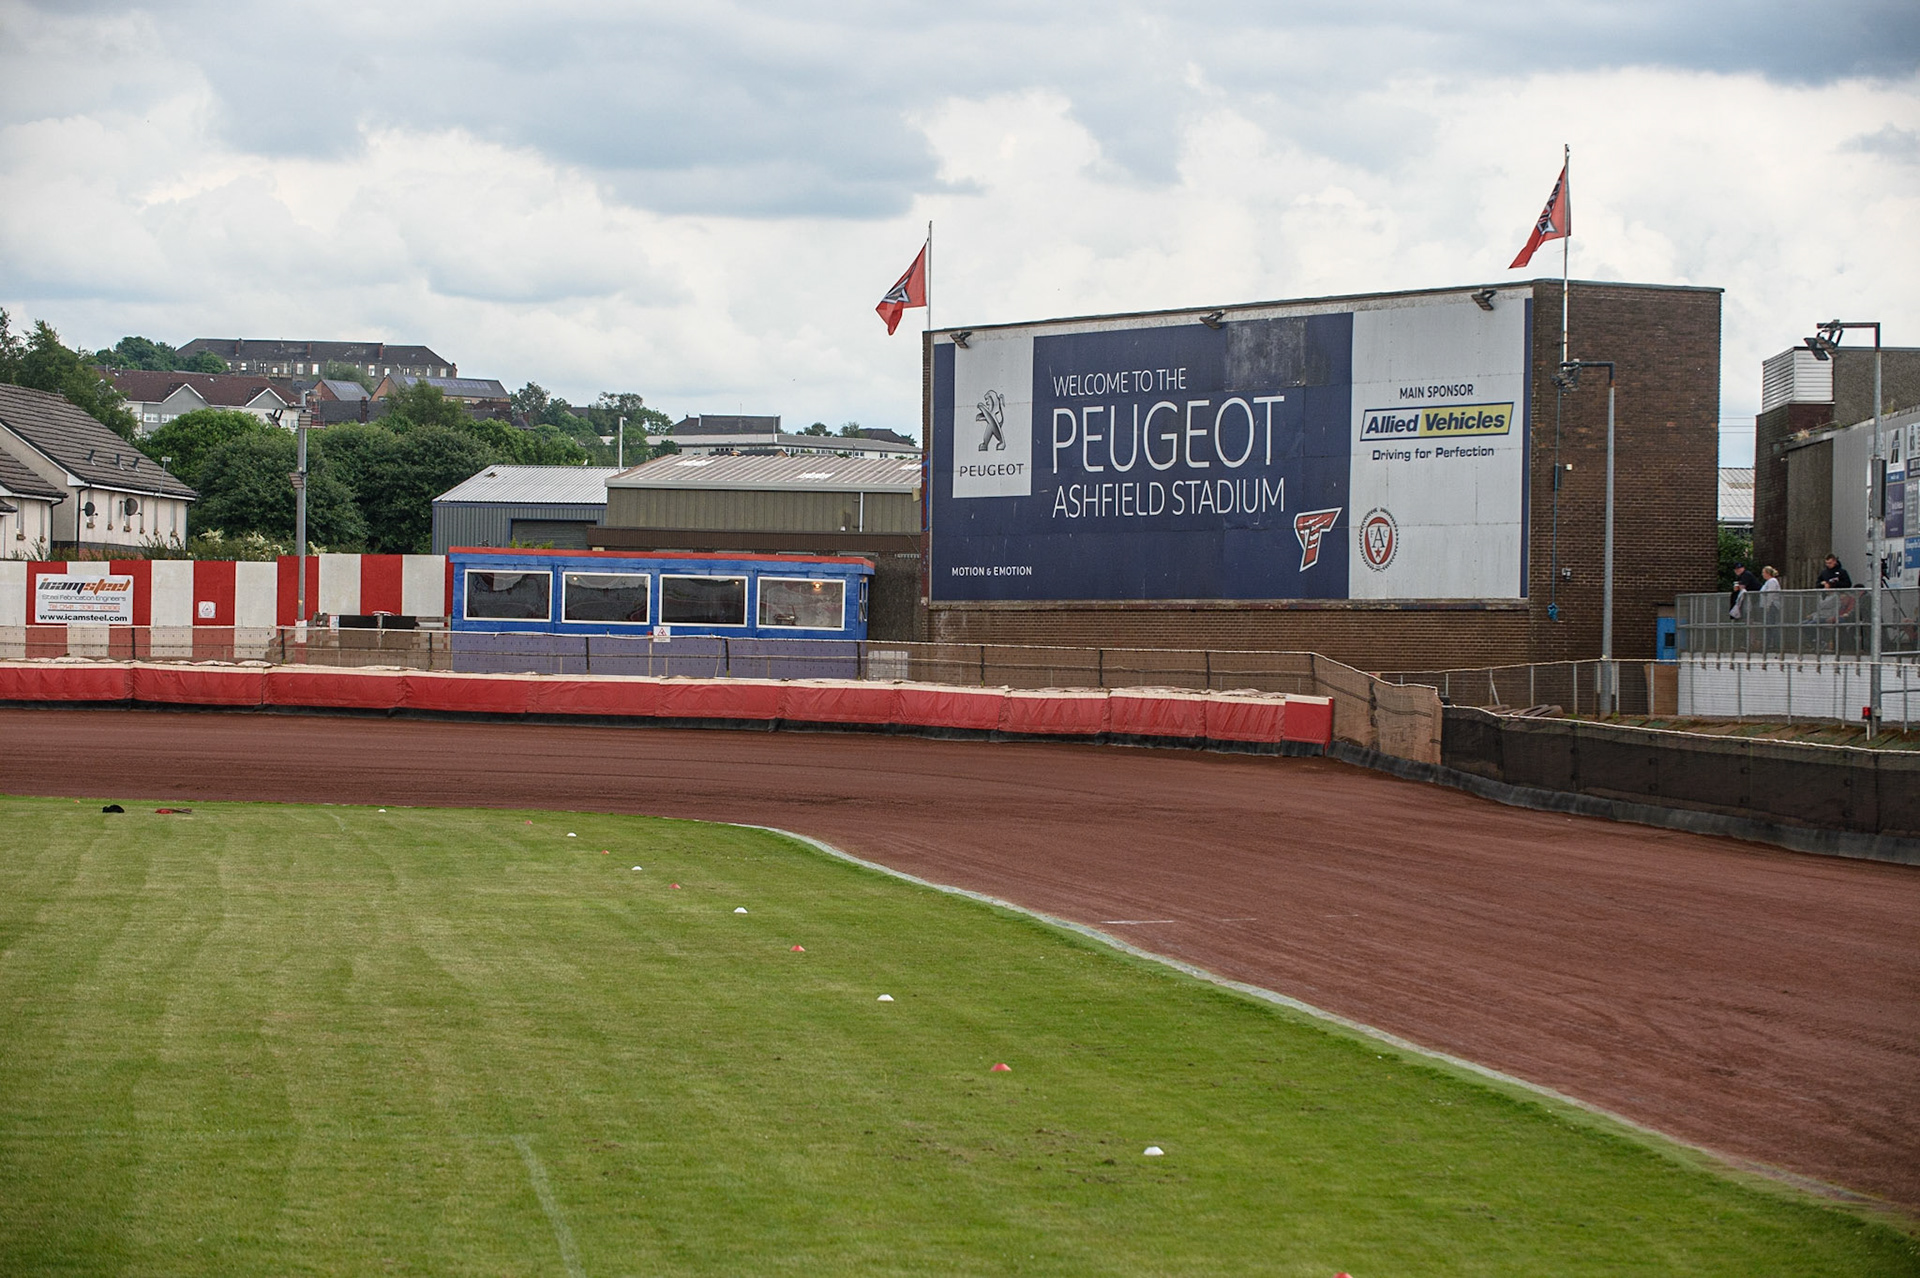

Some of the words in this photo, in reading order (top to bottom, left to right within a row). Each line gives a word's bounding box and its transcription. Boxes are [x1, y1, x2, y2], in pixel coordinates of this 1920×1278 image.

[1052, 371, 1129, 397] WELCOME
[1132, 370, 1153, 393] TO
[1156, 367, 1187, 391] THE
[1399, 385, 1425, 400] MAIN
[1427, 383, 1474, 398] SPONSOR
[1365, 414, 1420, 434] Allied
[1424, 410, 1506, 432] Vehicles
[1052, 395, 1286, 474] PEUGEOT
[1371, 449, 1412, 462] Driving
[1415, 448, 1432, 459] for
[1435, 446, 1495, 459] Perfection
[959, 462, 1025, 477] PEUGEOT
[1052, 481, 1166, 518] ASHFIELD
[1172, 476, 1286, 516] STADIUM
[951, 566, 985, 577] MOTION
[986, 567, 993, 577] &
[993, 565, 1032, 577] EMOTION
[39, 578, 131, 595] icamsteel
[40, 613, 128, 622] www.icamsteel.com
